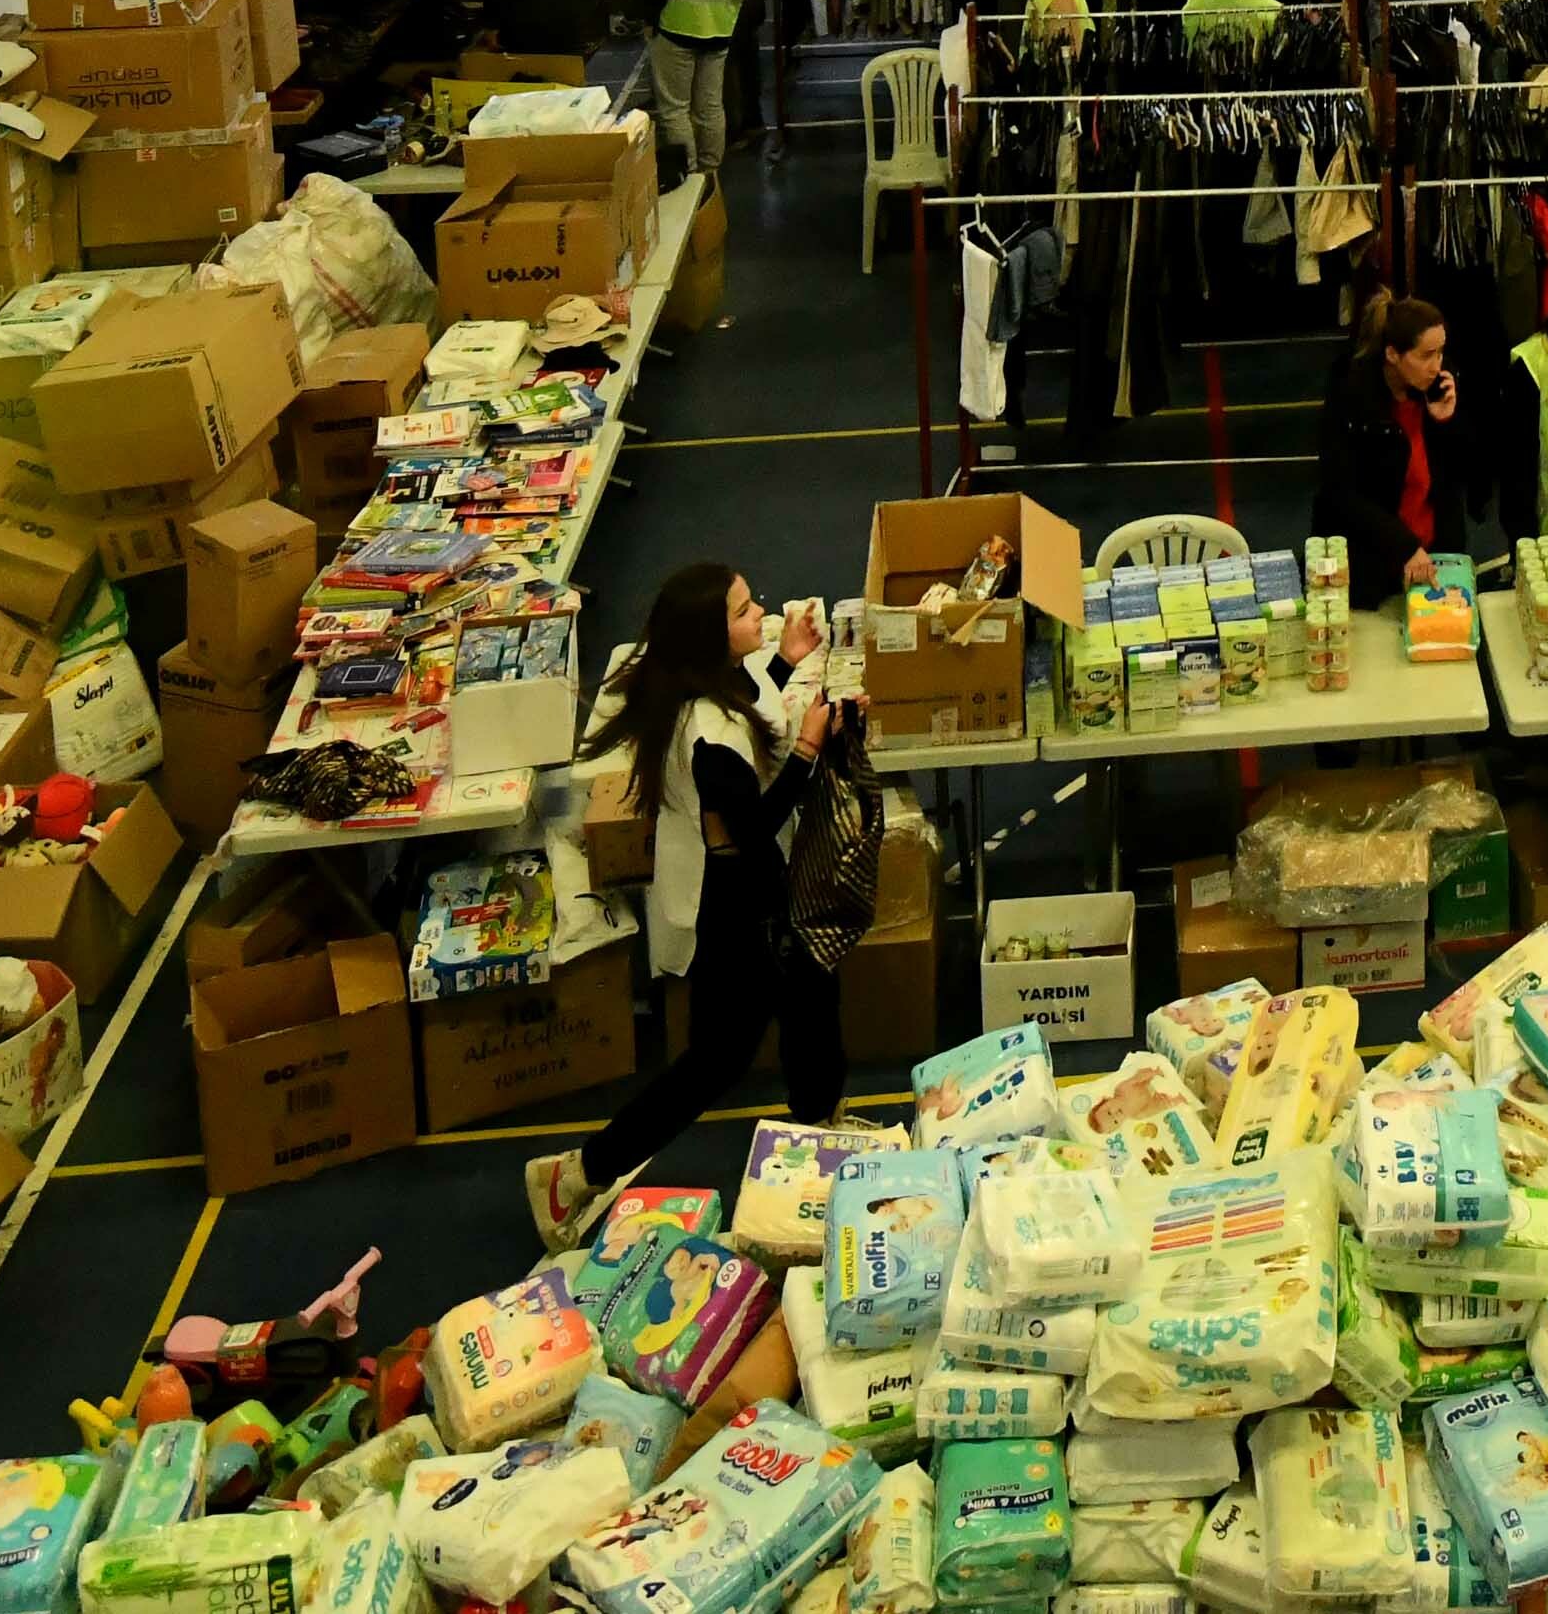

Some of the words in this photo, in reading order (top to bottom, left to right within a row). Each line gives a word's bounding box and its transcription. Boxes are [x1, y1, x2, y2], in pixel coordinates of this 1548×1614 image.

[78, 65, 159, 83] GROUP
[486, 266, 561, 284] KOTON
[73, 675, 114, 710] Sleepy
[1018, 985, 1090, 1002] YARDIM
[1394, 1138, 1418, 1186] BABY
[871, 1230, 887, 1291] molfix
[458, 1329, 492, 1390] minies
[1445, 1391, 1512, 1426] molfix
[1011, 1487, 1052, 1509] Jenny
[1211, 1503, 1240, 1541] Sleepy
